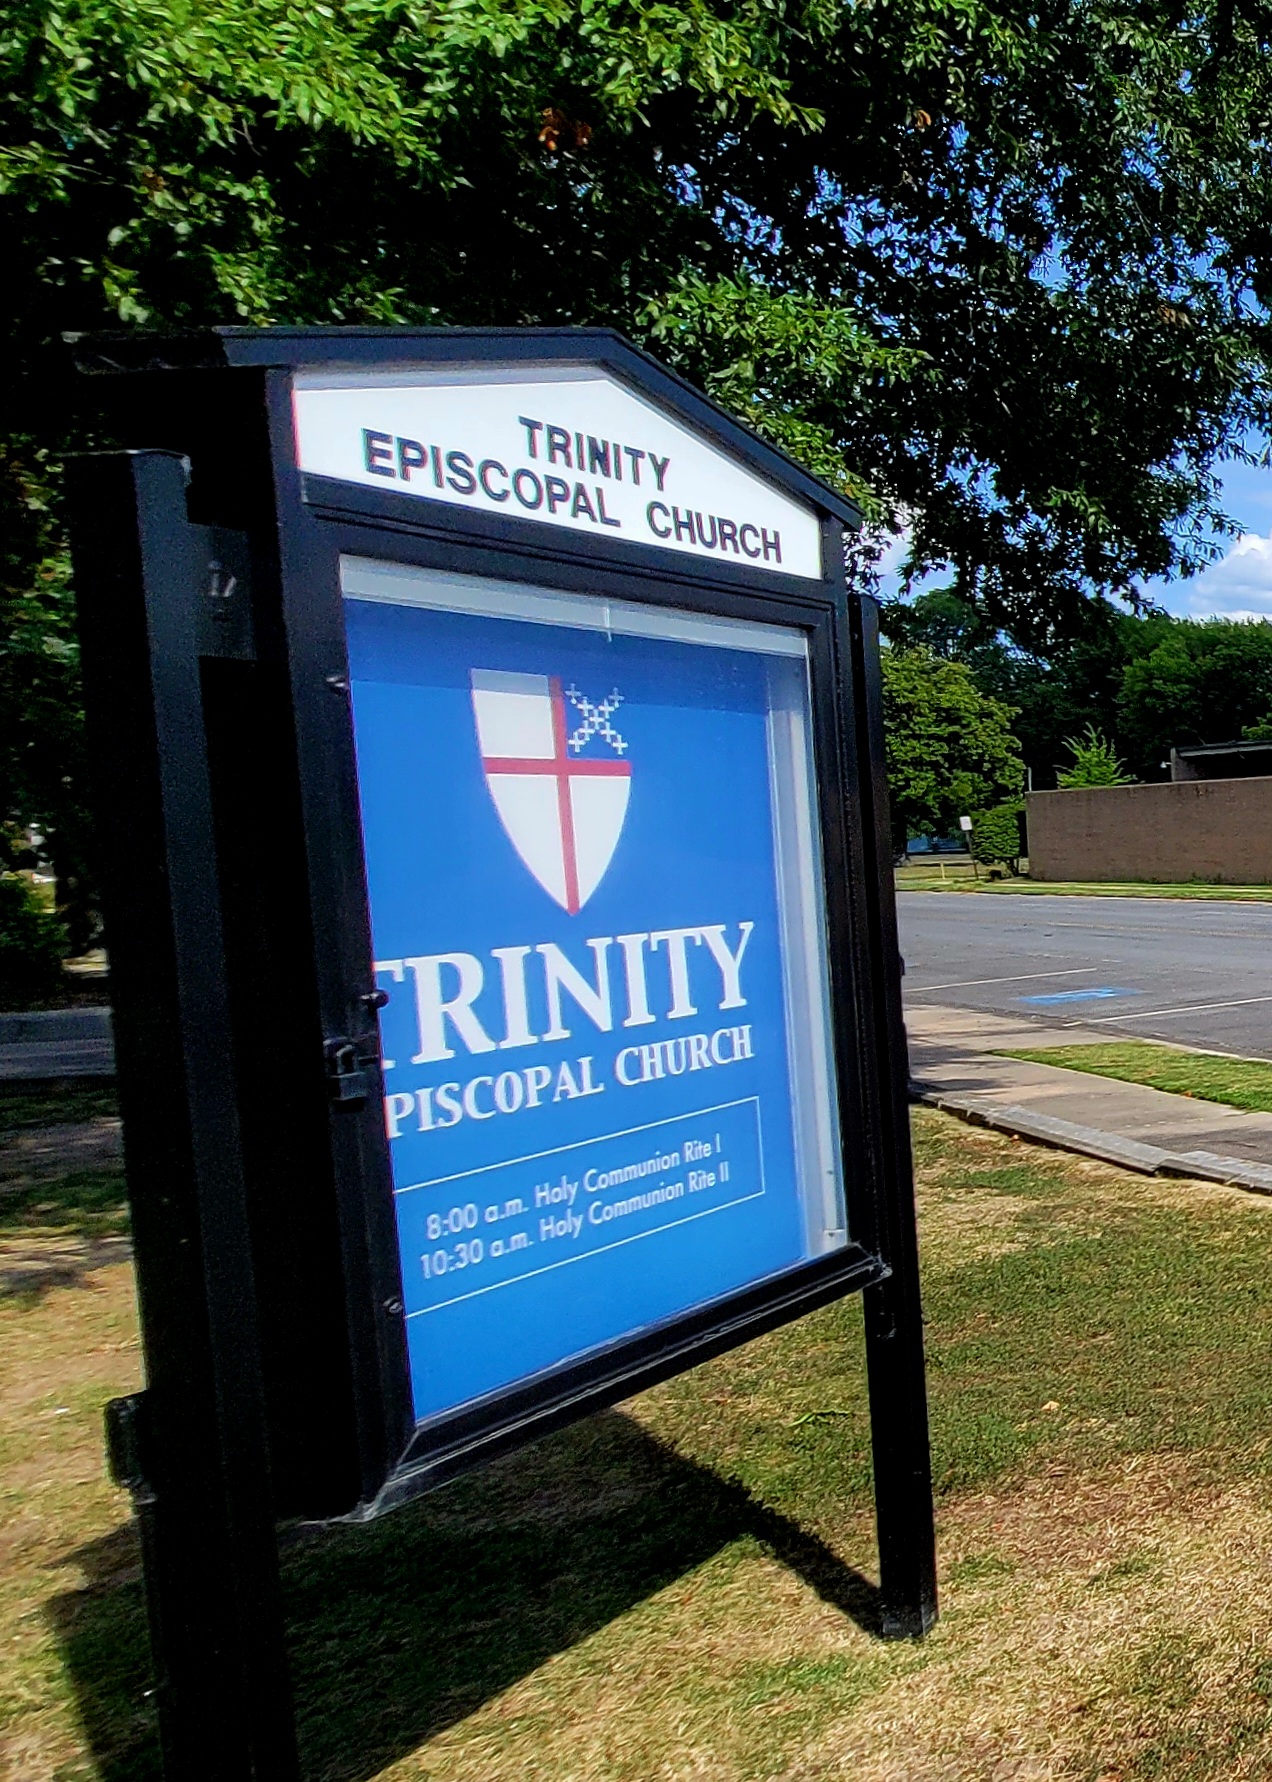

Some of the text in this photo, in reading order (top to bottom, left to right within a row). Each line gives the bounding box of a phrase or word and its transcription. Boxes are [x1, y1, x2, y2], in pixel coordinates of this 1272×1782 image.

[361, 428, 782, 563] EPISCOPAL CHURCH
[518, 415, 670, 491] TRINITY
[386, 1024, 755, 1138] PISCOPAL CHURCH
[420, 1161, 729, 1279] 10:30 a.m. Holy Communion Rite II
[426, 1133, 721, 1240] 8:00 a.m. Holy Communion Rite I
